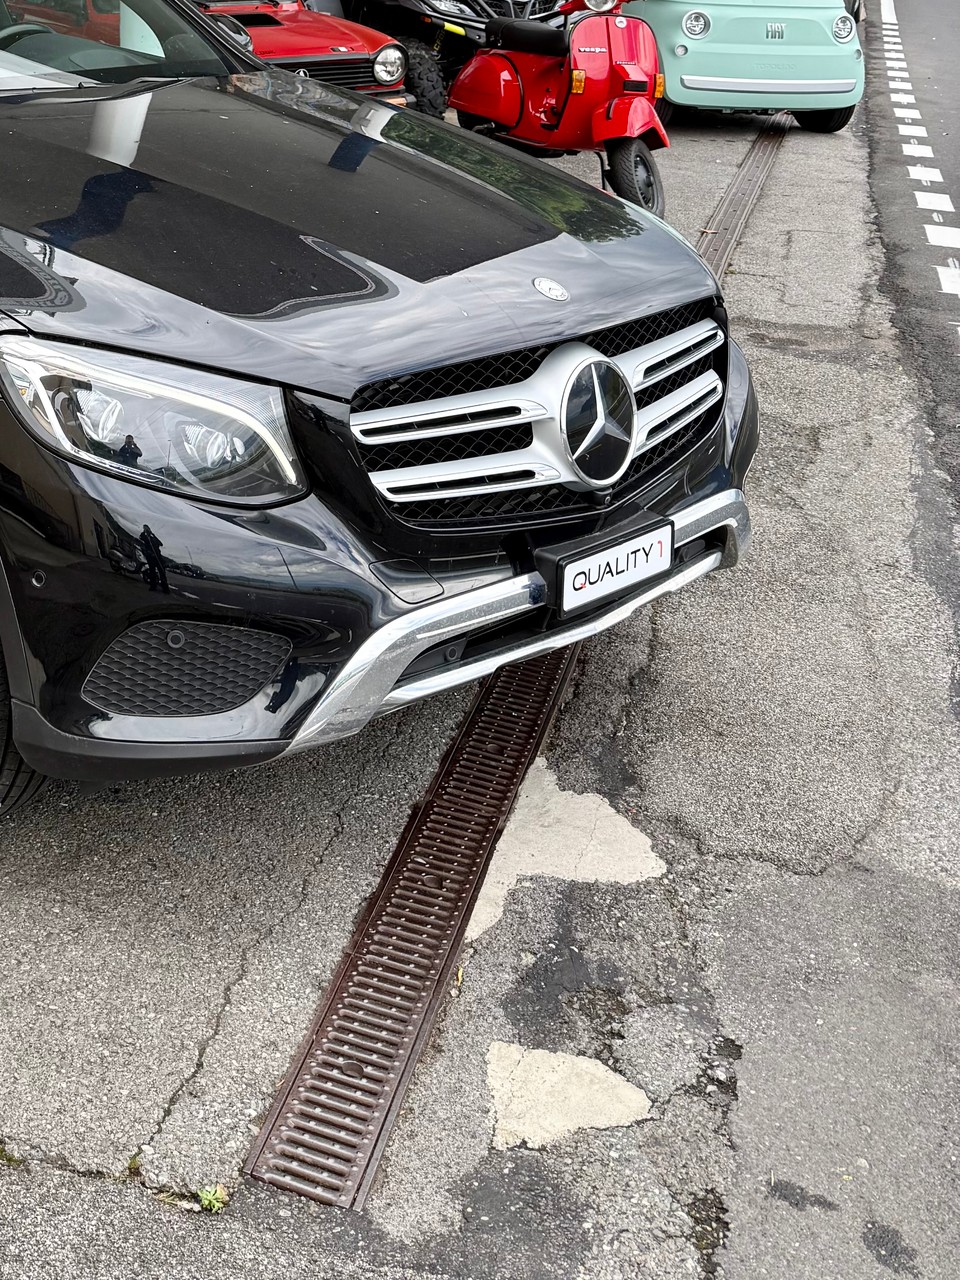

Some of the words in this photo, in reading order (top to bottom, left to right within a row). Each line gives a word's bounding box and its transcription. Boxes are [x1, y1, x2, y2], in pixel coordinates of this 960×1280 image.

[765, 22, 787, 40] FIAT
[572, 542, 654, 592] QUALITY
[656, 539, 664, 558] 1
